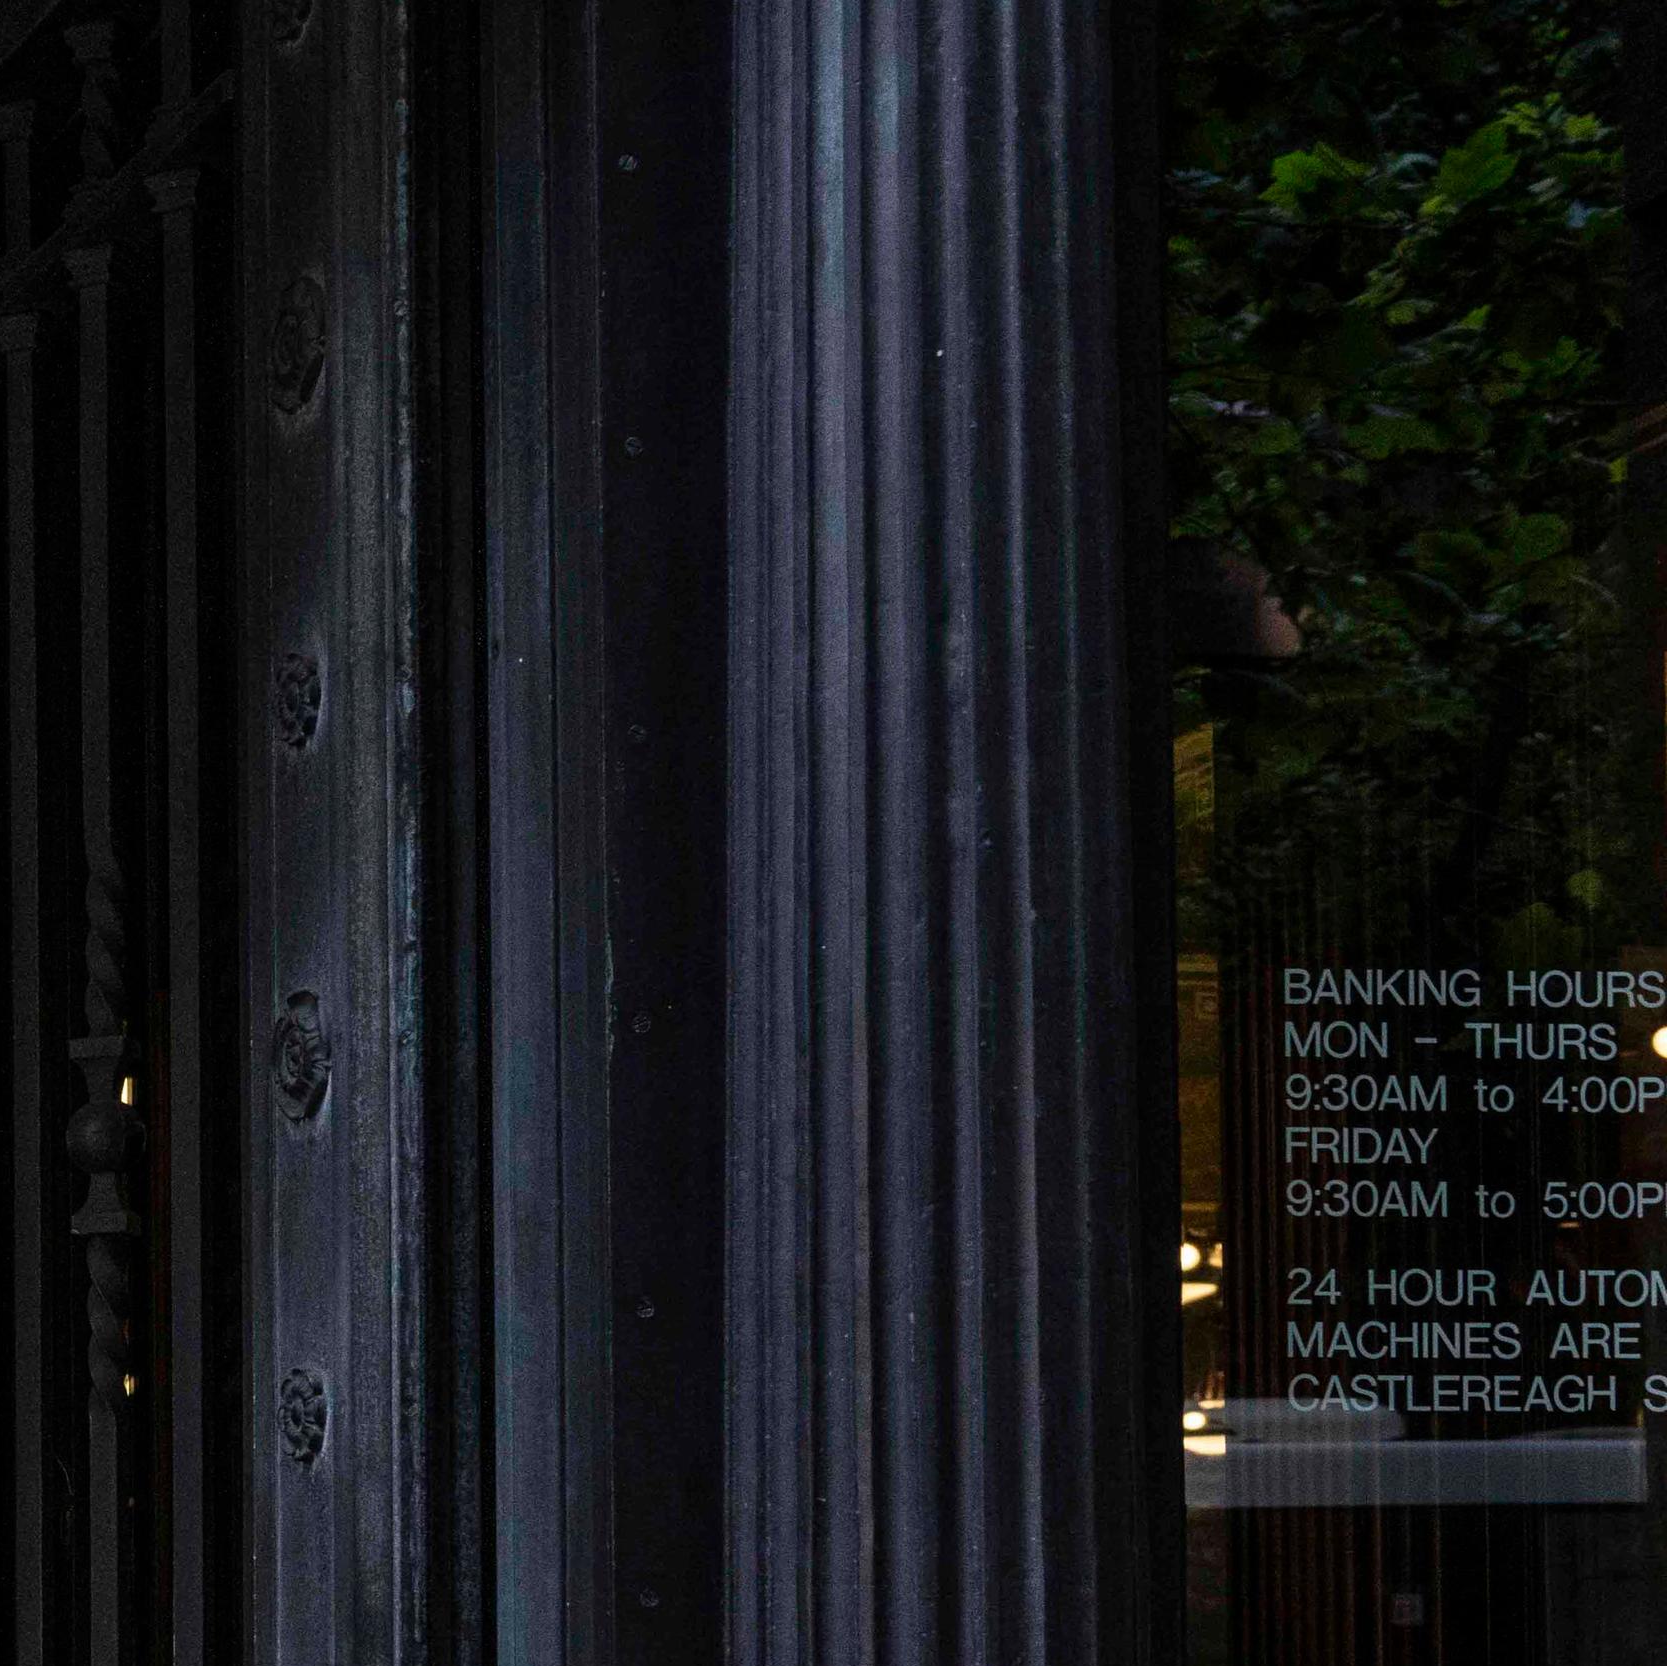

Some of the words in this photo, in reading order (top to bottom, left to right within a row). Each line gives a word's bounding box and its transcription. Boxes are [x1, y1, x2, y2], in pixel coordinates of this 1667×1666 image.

[1284, 968, 1480, 1007] BANKING
[1507, 969, 1666, 1009] HOURS
[1285, 1021, 1388, 1059] MON
[1464, 1022, 1618, 1061] THURS
[1286, 1073, 1448, 1112] 9:30AM
[1474, 1079, 1515, 1114] to
[1542, 1076, 1667, 1114] 4:00P
[1285, 1126, 1438, 1164] FRIDAY
[1286, 1179, 1448, 1218] 9:30AM
[1475, 1184, 1515, 1219] to
[1543, 1181, 1667, 1219] 5:00P
[1288, 1267, 1341, 1305] 24
[1368, 1268, 1496, 1306] HOUR
[1287, 1321, 1521, 1360] MACHINES
[1550, 1322, 1641, 1359] ARE
[1288, 1373, 1616, 1413] CASTLEREAGH
